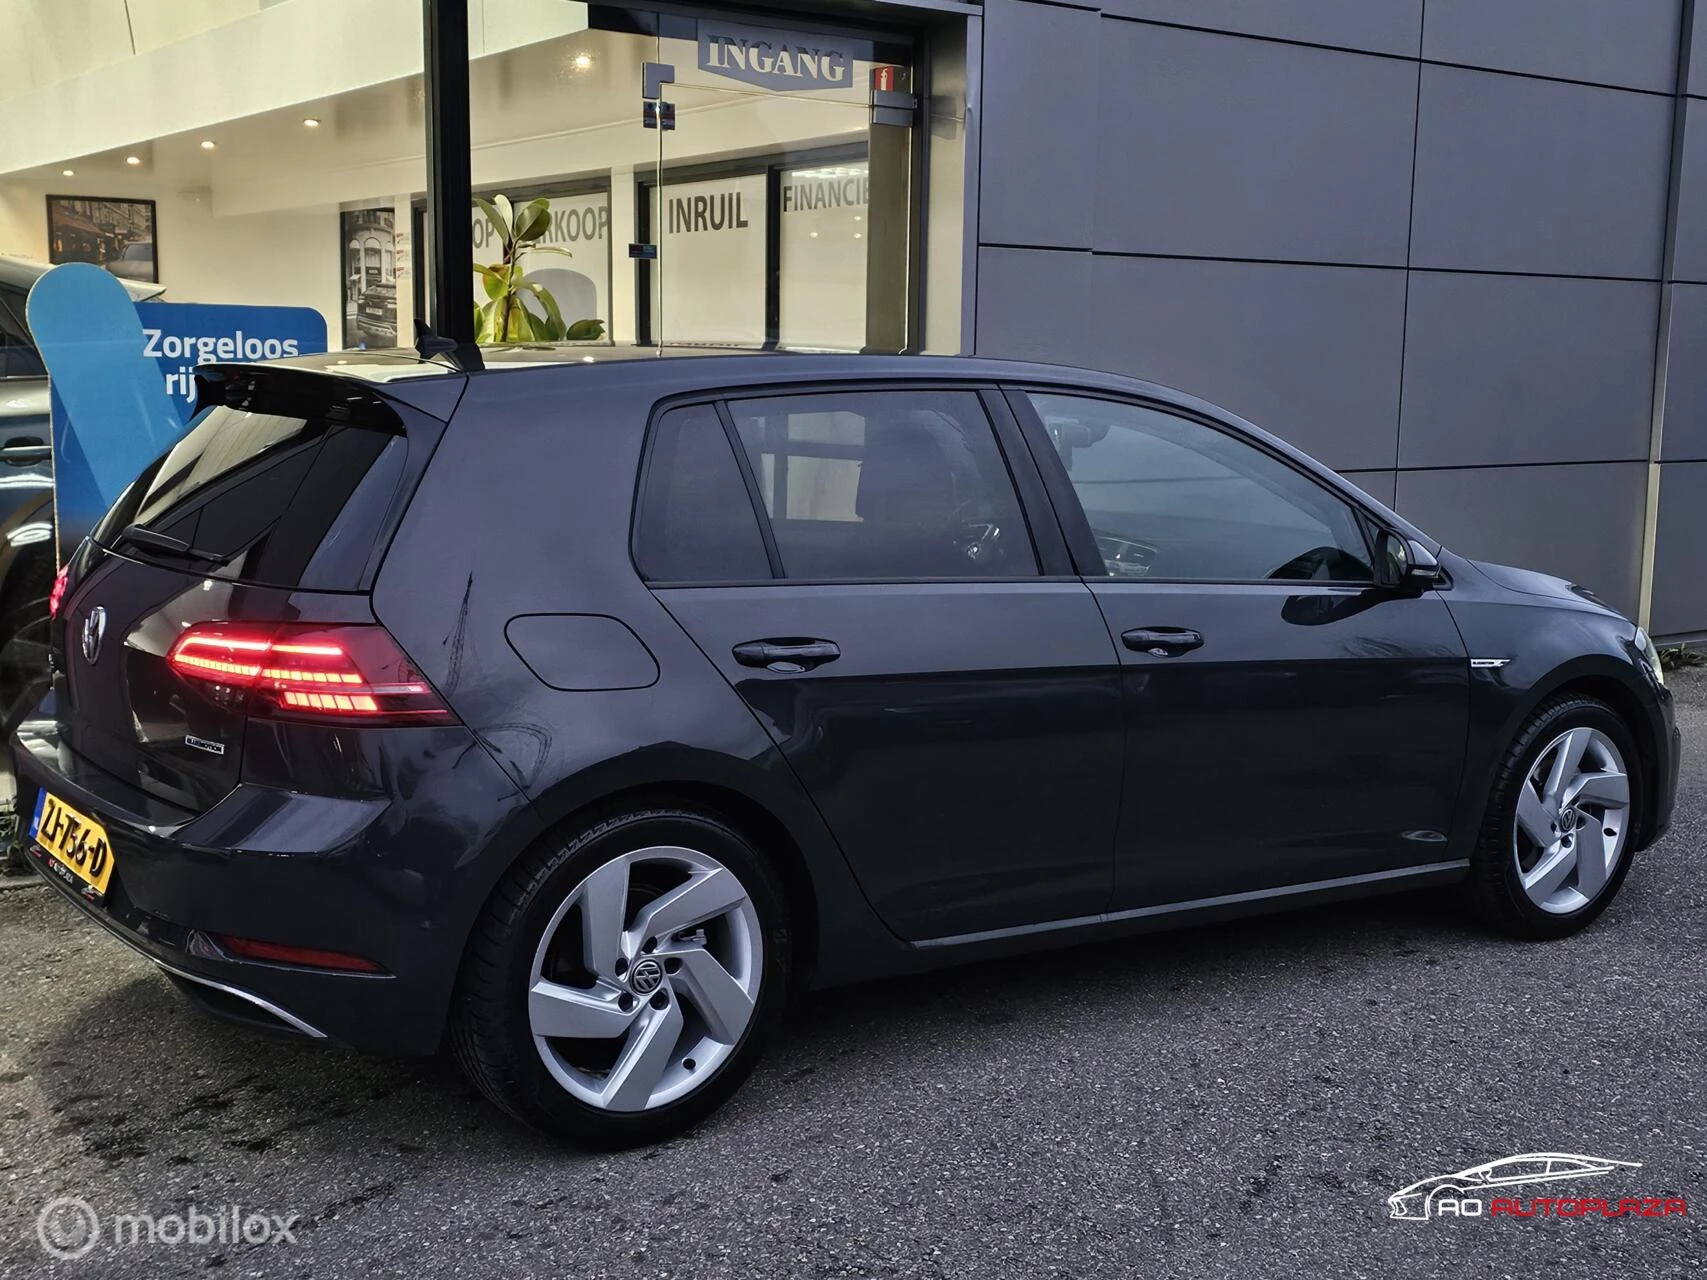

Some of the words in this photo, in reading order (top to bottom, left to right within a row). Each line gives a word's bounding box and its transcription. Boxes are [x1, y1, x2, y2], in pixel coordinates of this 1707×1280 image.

[706, 34, 845, 81] INGANG
[534, 206, 609, 244] RKOOP
[669, 192, 749, 234] INRUIL
[472, 218, 495, 249] OP
[142, 328, 299, 364] Zorgeloos
